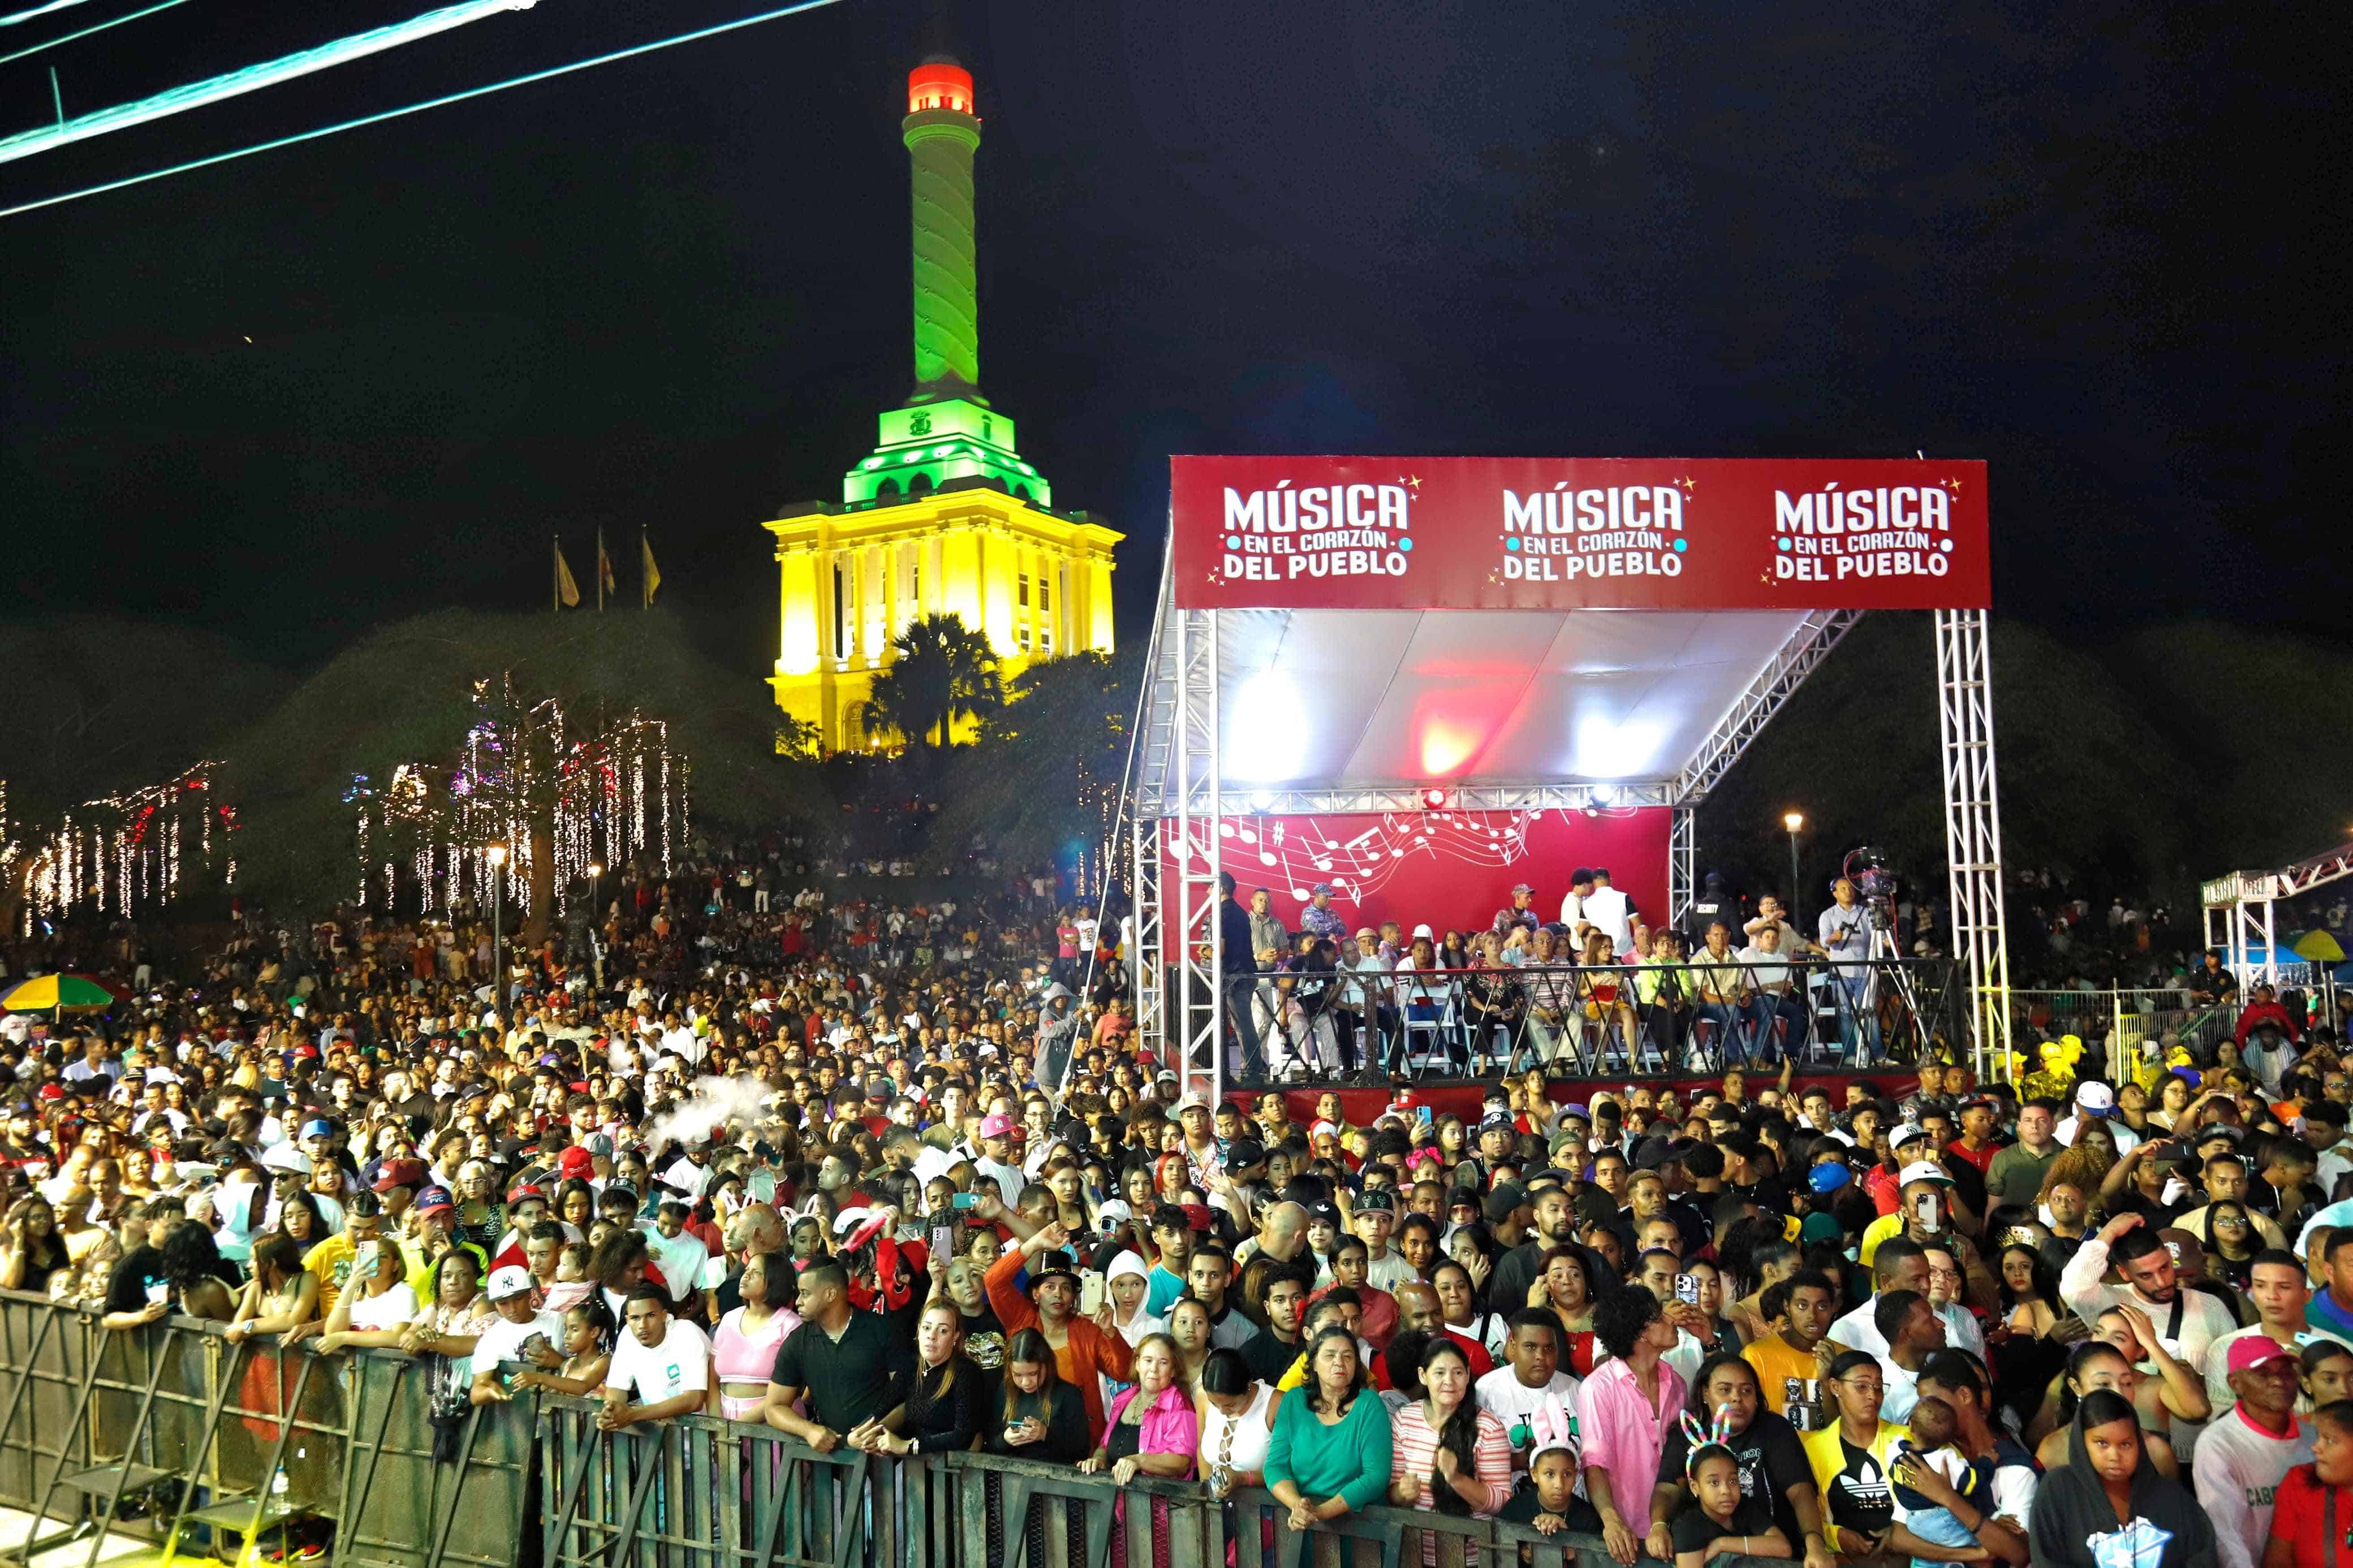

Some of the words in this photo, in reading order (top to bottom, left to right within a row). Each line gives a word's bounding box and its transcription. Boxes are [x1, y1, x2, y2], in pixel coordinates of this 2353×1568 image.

[1224, 480, 1408, 533] MÚSICA
[1503, 481, 1682, 534] MÚSICA
[1775, 482, 1949, 534] MÚSICA
[1244, 534, 1269, 554] EN
[1272, 535, 1296, 554] EL
[1300, 526, 1387, 552] CORAZÓN
[1523, 536, 1548, 555] EN
[1550, 537, 1574, 555] EL
[1577, 528, 1662, 553] CORAZÓN
[1794, 536, 1817, 555] EN
[1821, 538, 1844, 555] EL
[1847, 528, 1929, 552] CORAZÓN
[1224, 554, 1281, 580] DEL
[1288, 550, 1407, 580] PUEBLO
[1503, 555, 1559, 581] DEL
[1566, 551, 1682, 580] PUEBLO
[1775, 555, 1829, 581] DEL
[1837, 551, 1949, 580] PUEBLO
